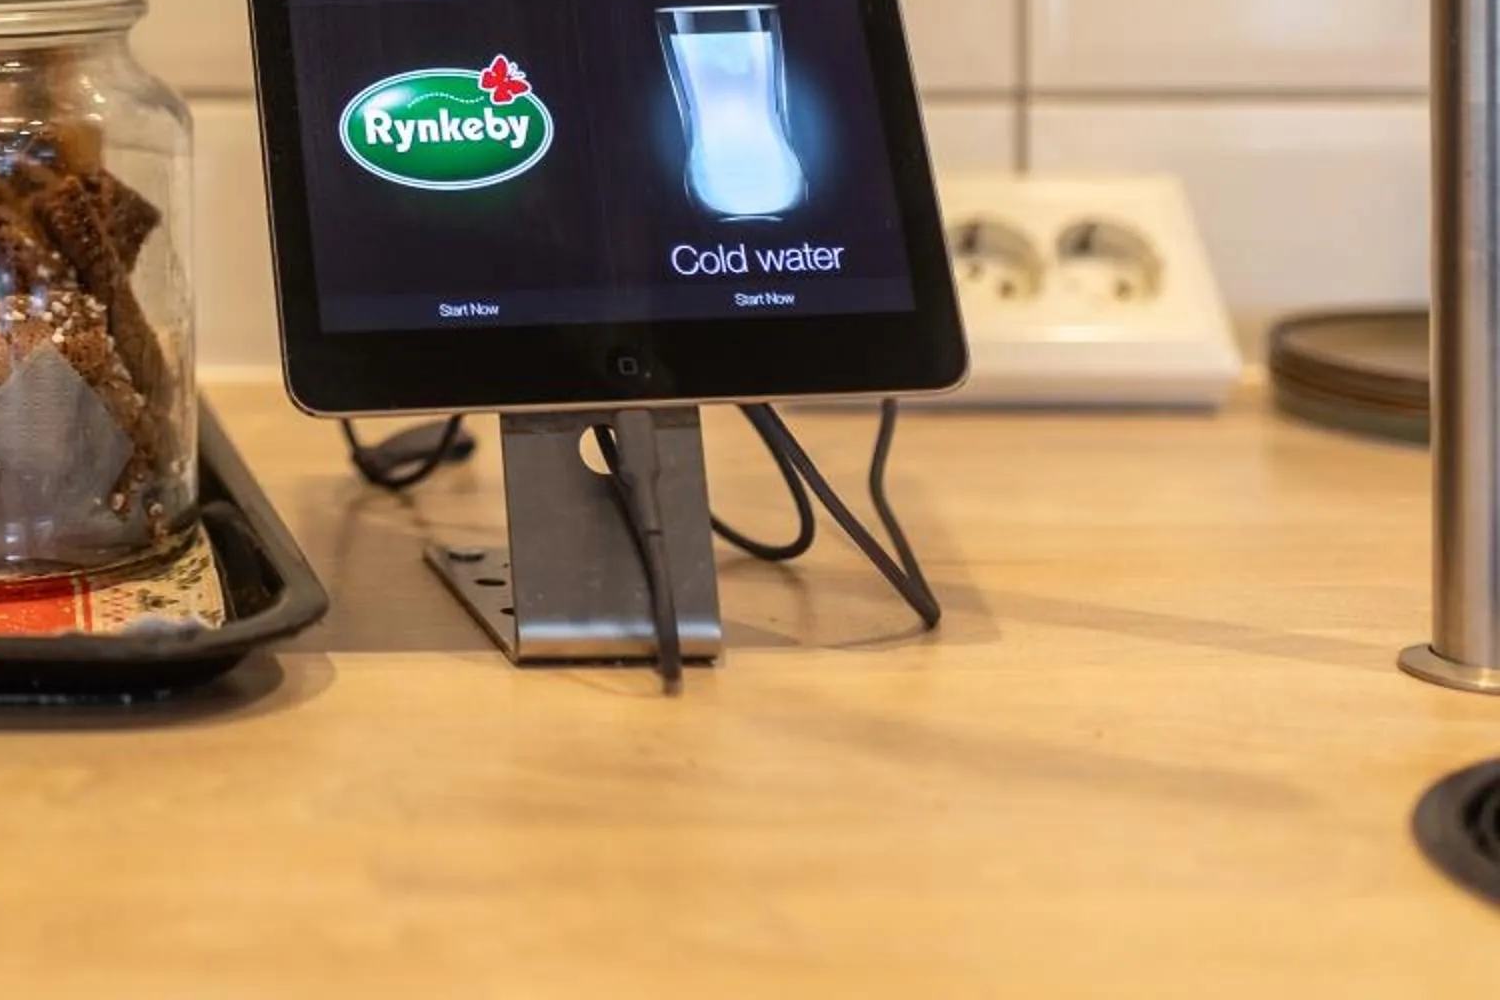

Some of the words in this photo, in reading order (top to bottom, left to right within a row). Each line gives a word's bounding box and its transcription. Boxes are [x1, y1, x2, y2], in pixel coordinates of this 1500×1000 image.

[363, 107, 530, 152] Rynkeby
[671, 243, 749, 275] Cold
[755, 242, 845, 272] water
[439, 303, 468, 317] Start
[469, 302, 499, 316] Now
[734, 293, 764, 307] Start
[765, 291, 795, 305] Now
